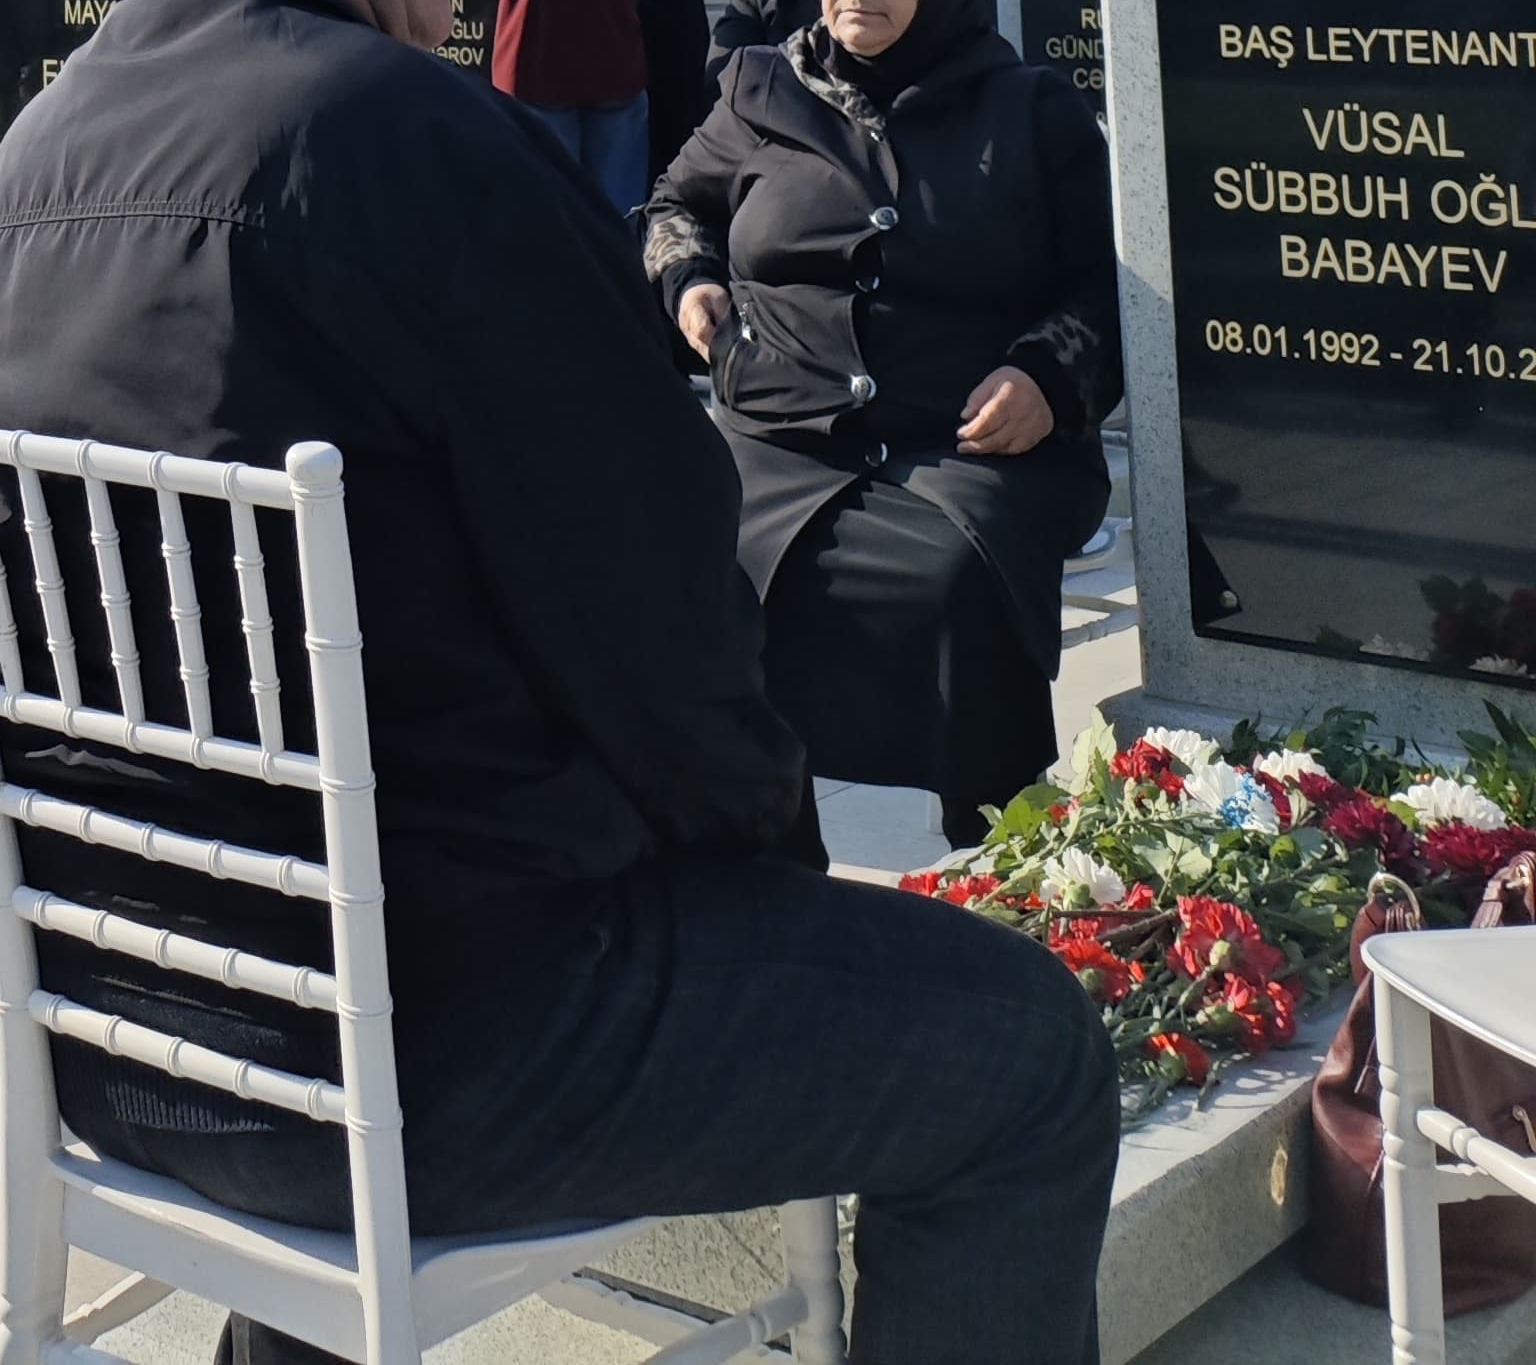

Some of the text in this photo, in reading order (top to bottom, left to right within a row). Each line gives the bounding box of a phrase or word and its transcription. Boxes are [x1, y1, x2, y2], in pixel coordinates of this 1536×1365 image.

[1219, 24, 1536, 68] BAŞ LEYTENANT
[1302, 103, 1465, 158] VÜSAL
[1214, 161, 1409, 221] SÜBBUH
[1280, 234, 1507, 293] BABAYEV
[1205, 319, 1381, 366] 08.01.1992
